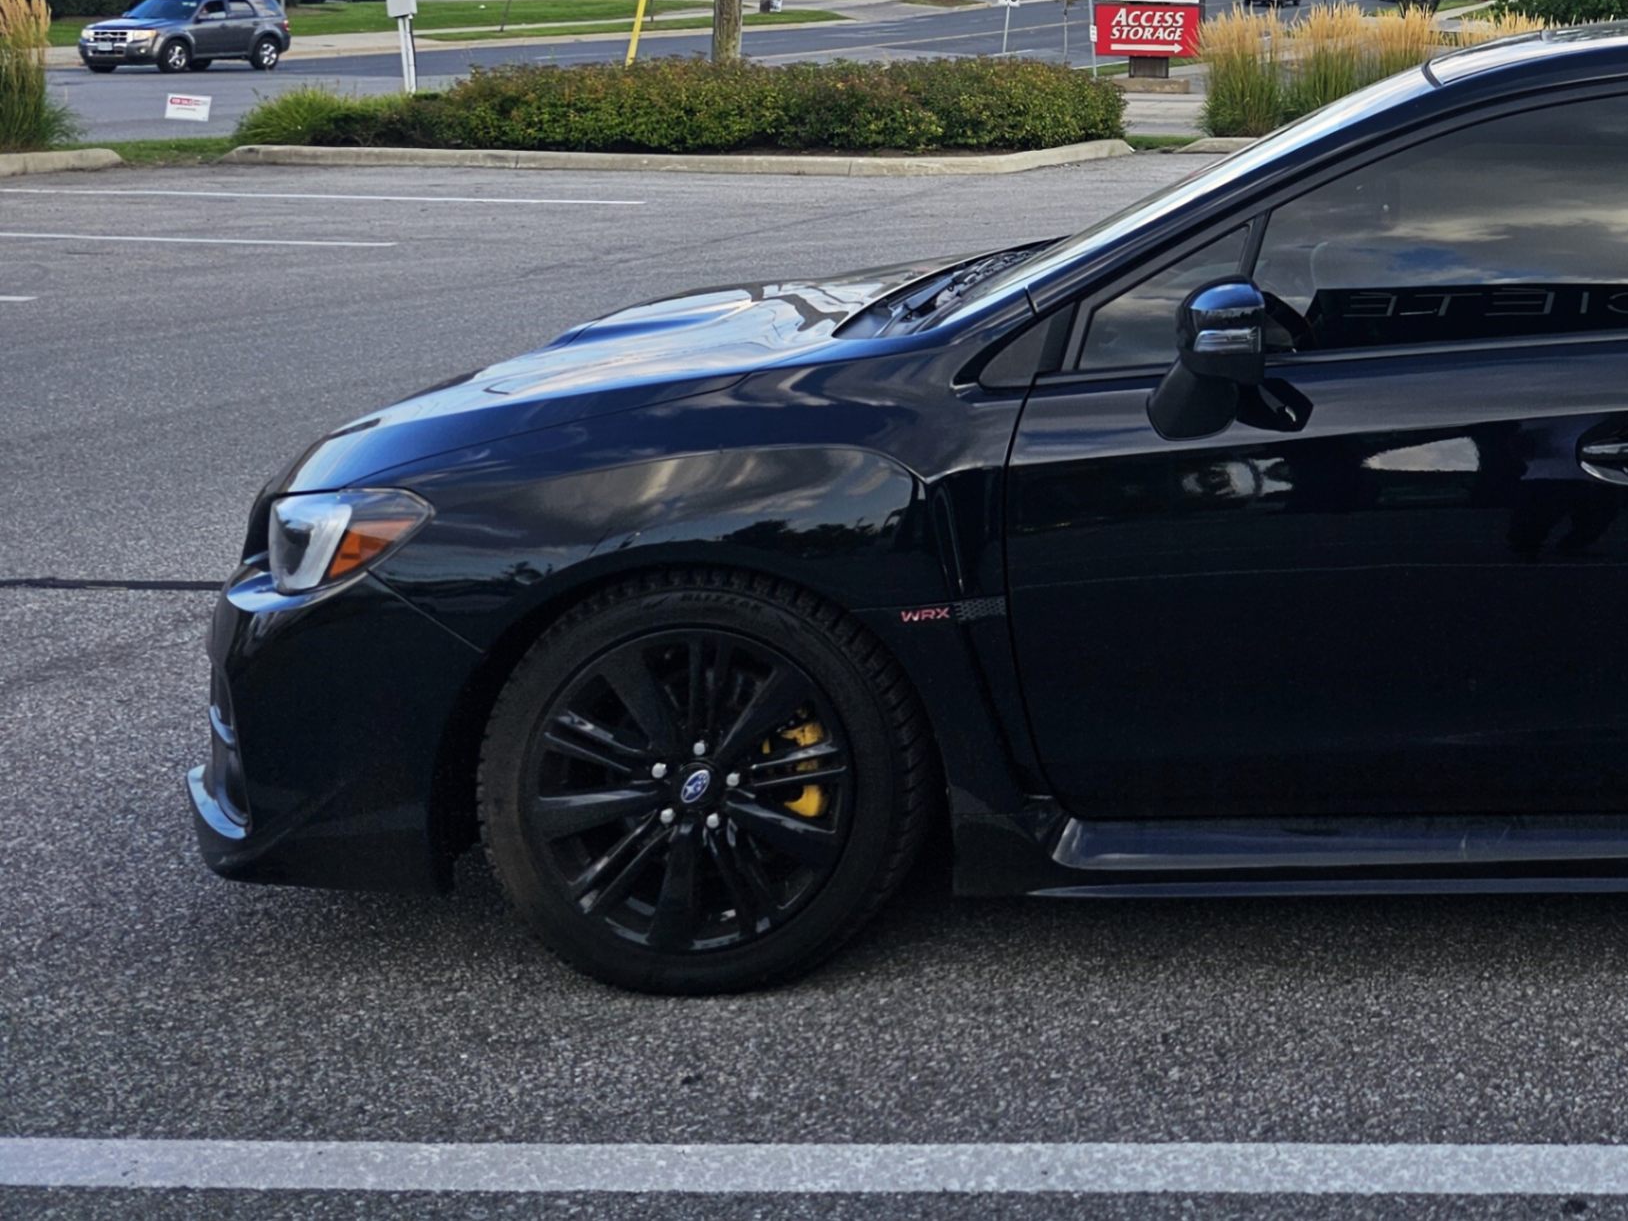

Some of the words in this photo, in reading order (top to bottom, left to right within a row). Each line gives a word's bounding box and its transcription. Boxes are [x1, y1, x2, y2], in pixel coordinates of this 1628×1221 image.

[1111, 8, 1184, 26] ACCESS
[1110, 27, 1184, 40] STORAGE
[901, 607, 950, 622] WRX
